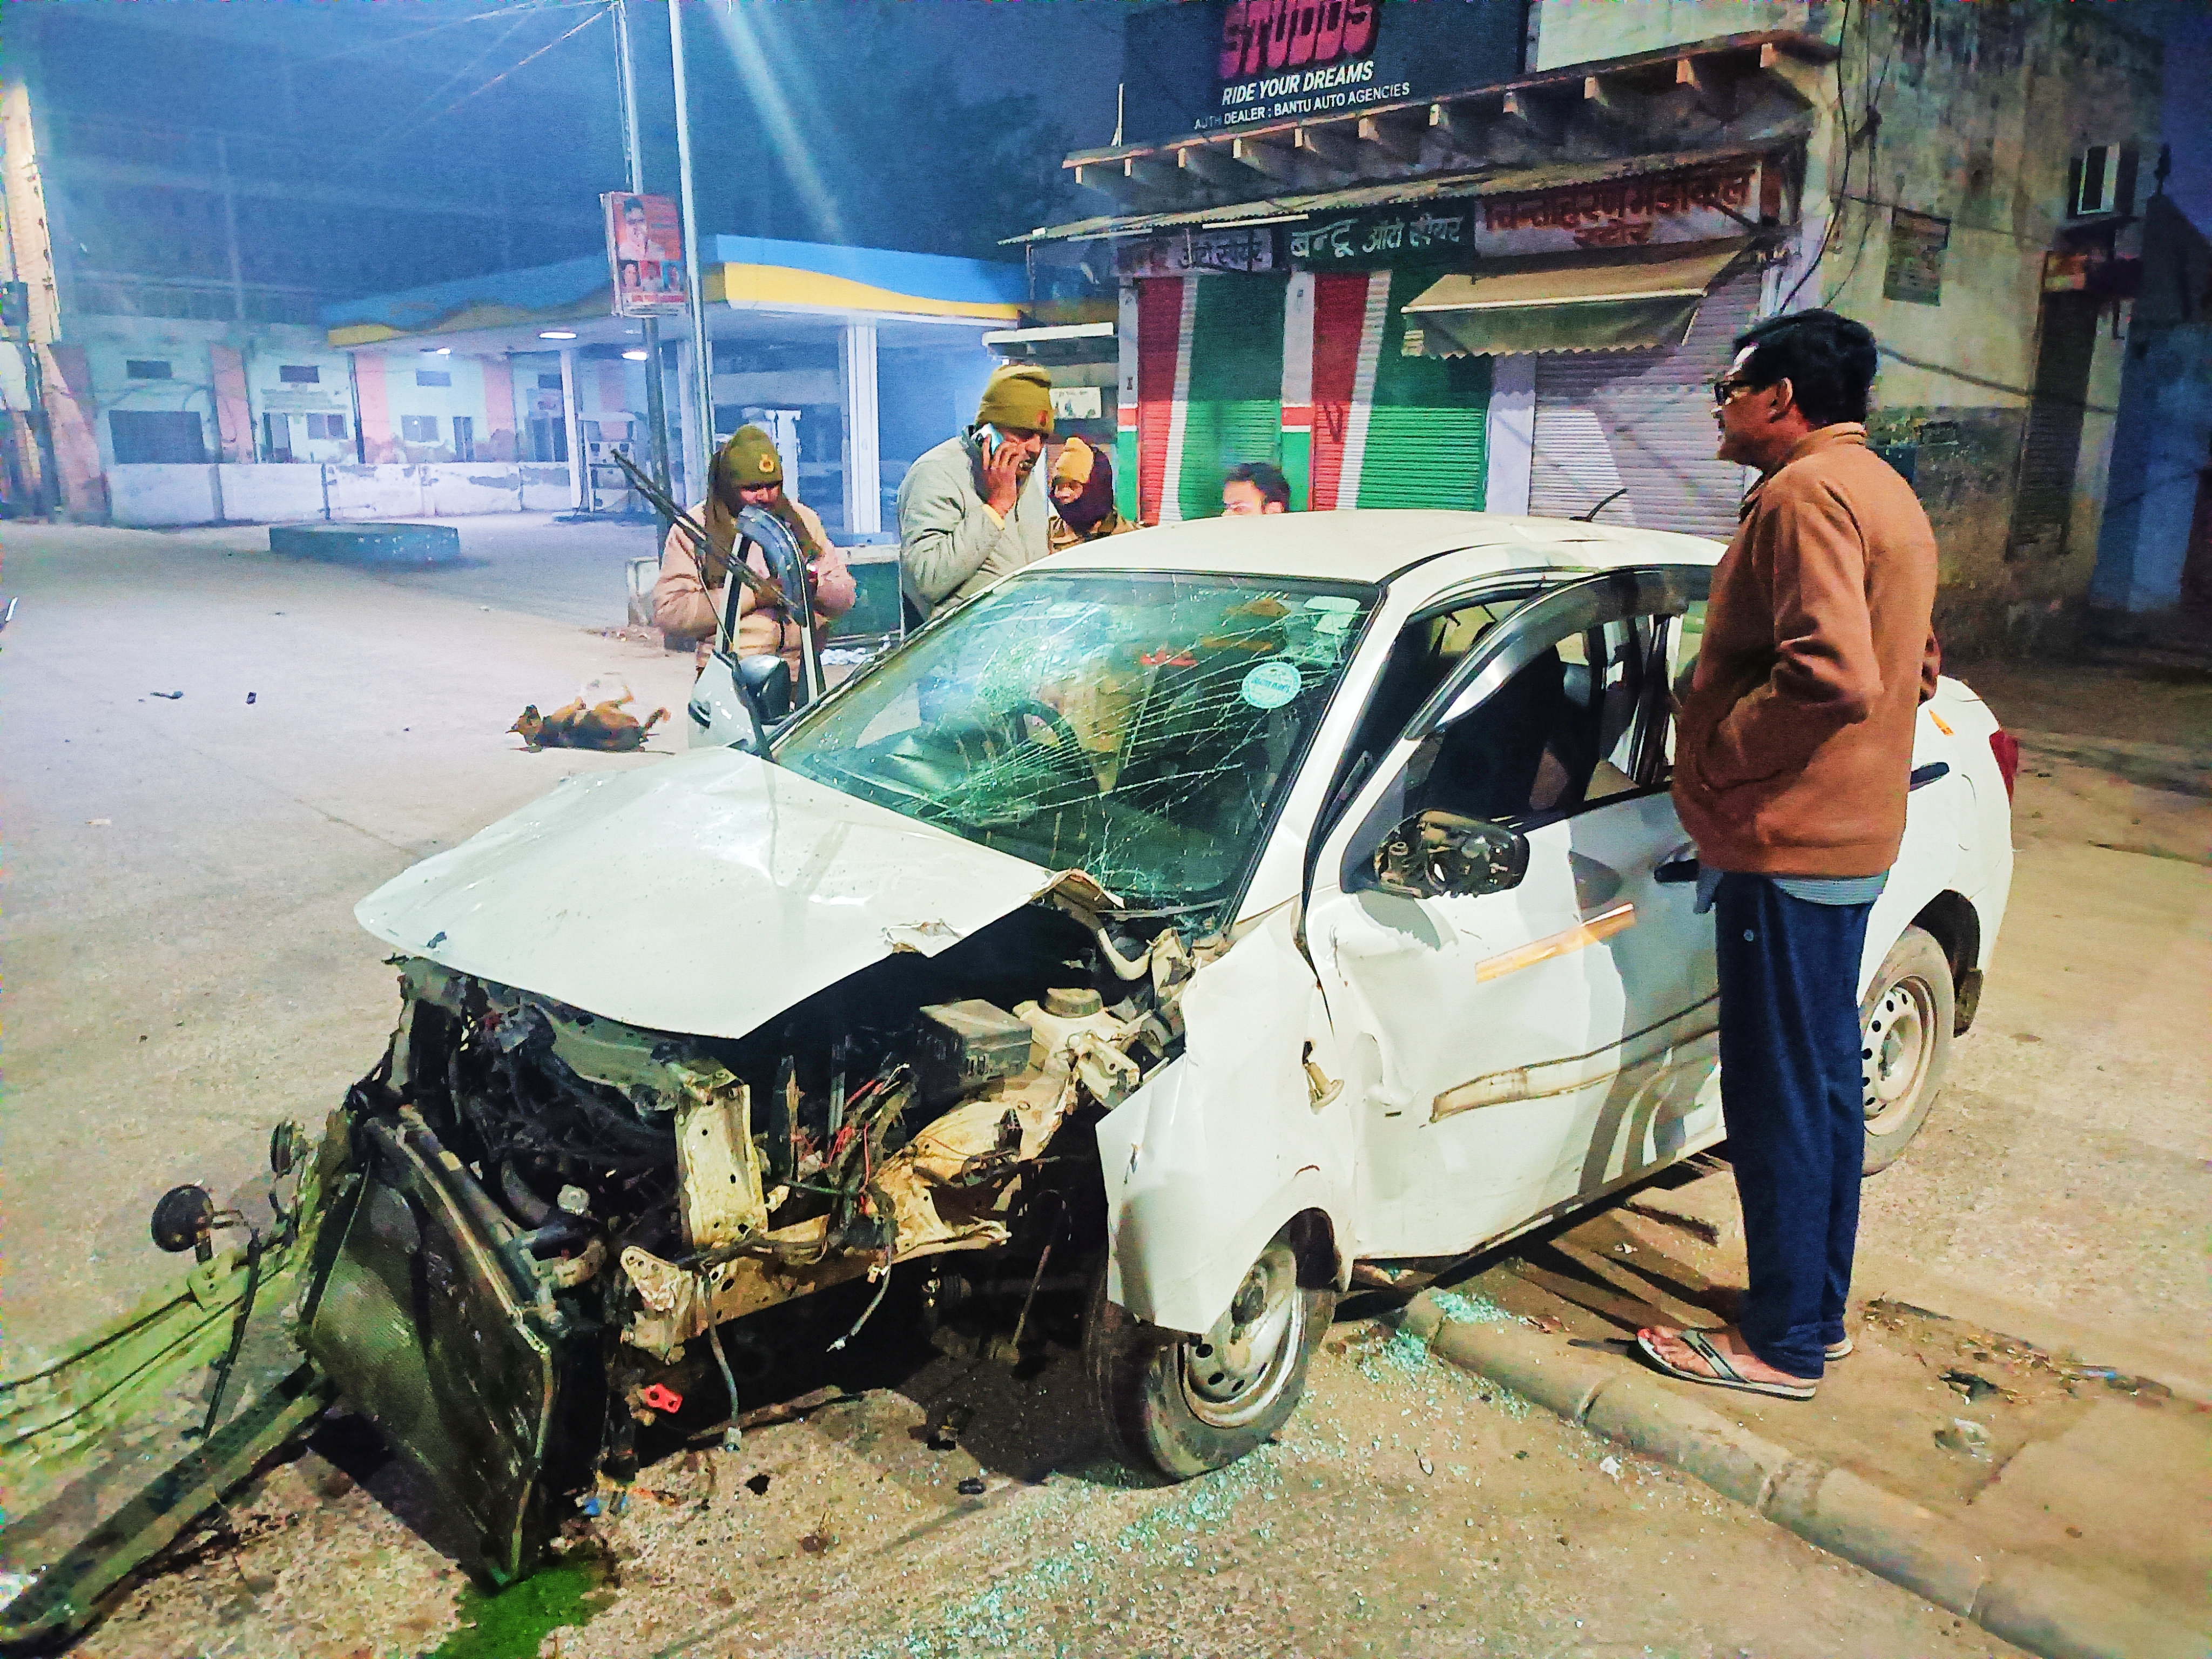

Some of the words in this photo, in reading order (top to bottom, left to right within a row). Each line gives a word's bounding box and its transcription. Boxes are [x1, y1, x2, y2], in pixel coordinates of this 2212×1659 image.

[1222, 82, 1257, 105] RIDE
[1260, 74, 1300, 99] YOUR
[1302, 60, 1374, 92] DREAMS
[1224, 106, 1265, 124] DEALER
[1274, 98, 1311, 116] BANTU
[1313, 93, 1345, 110] AUTO
[1347, 82, 1410, 105] AGENCIES
